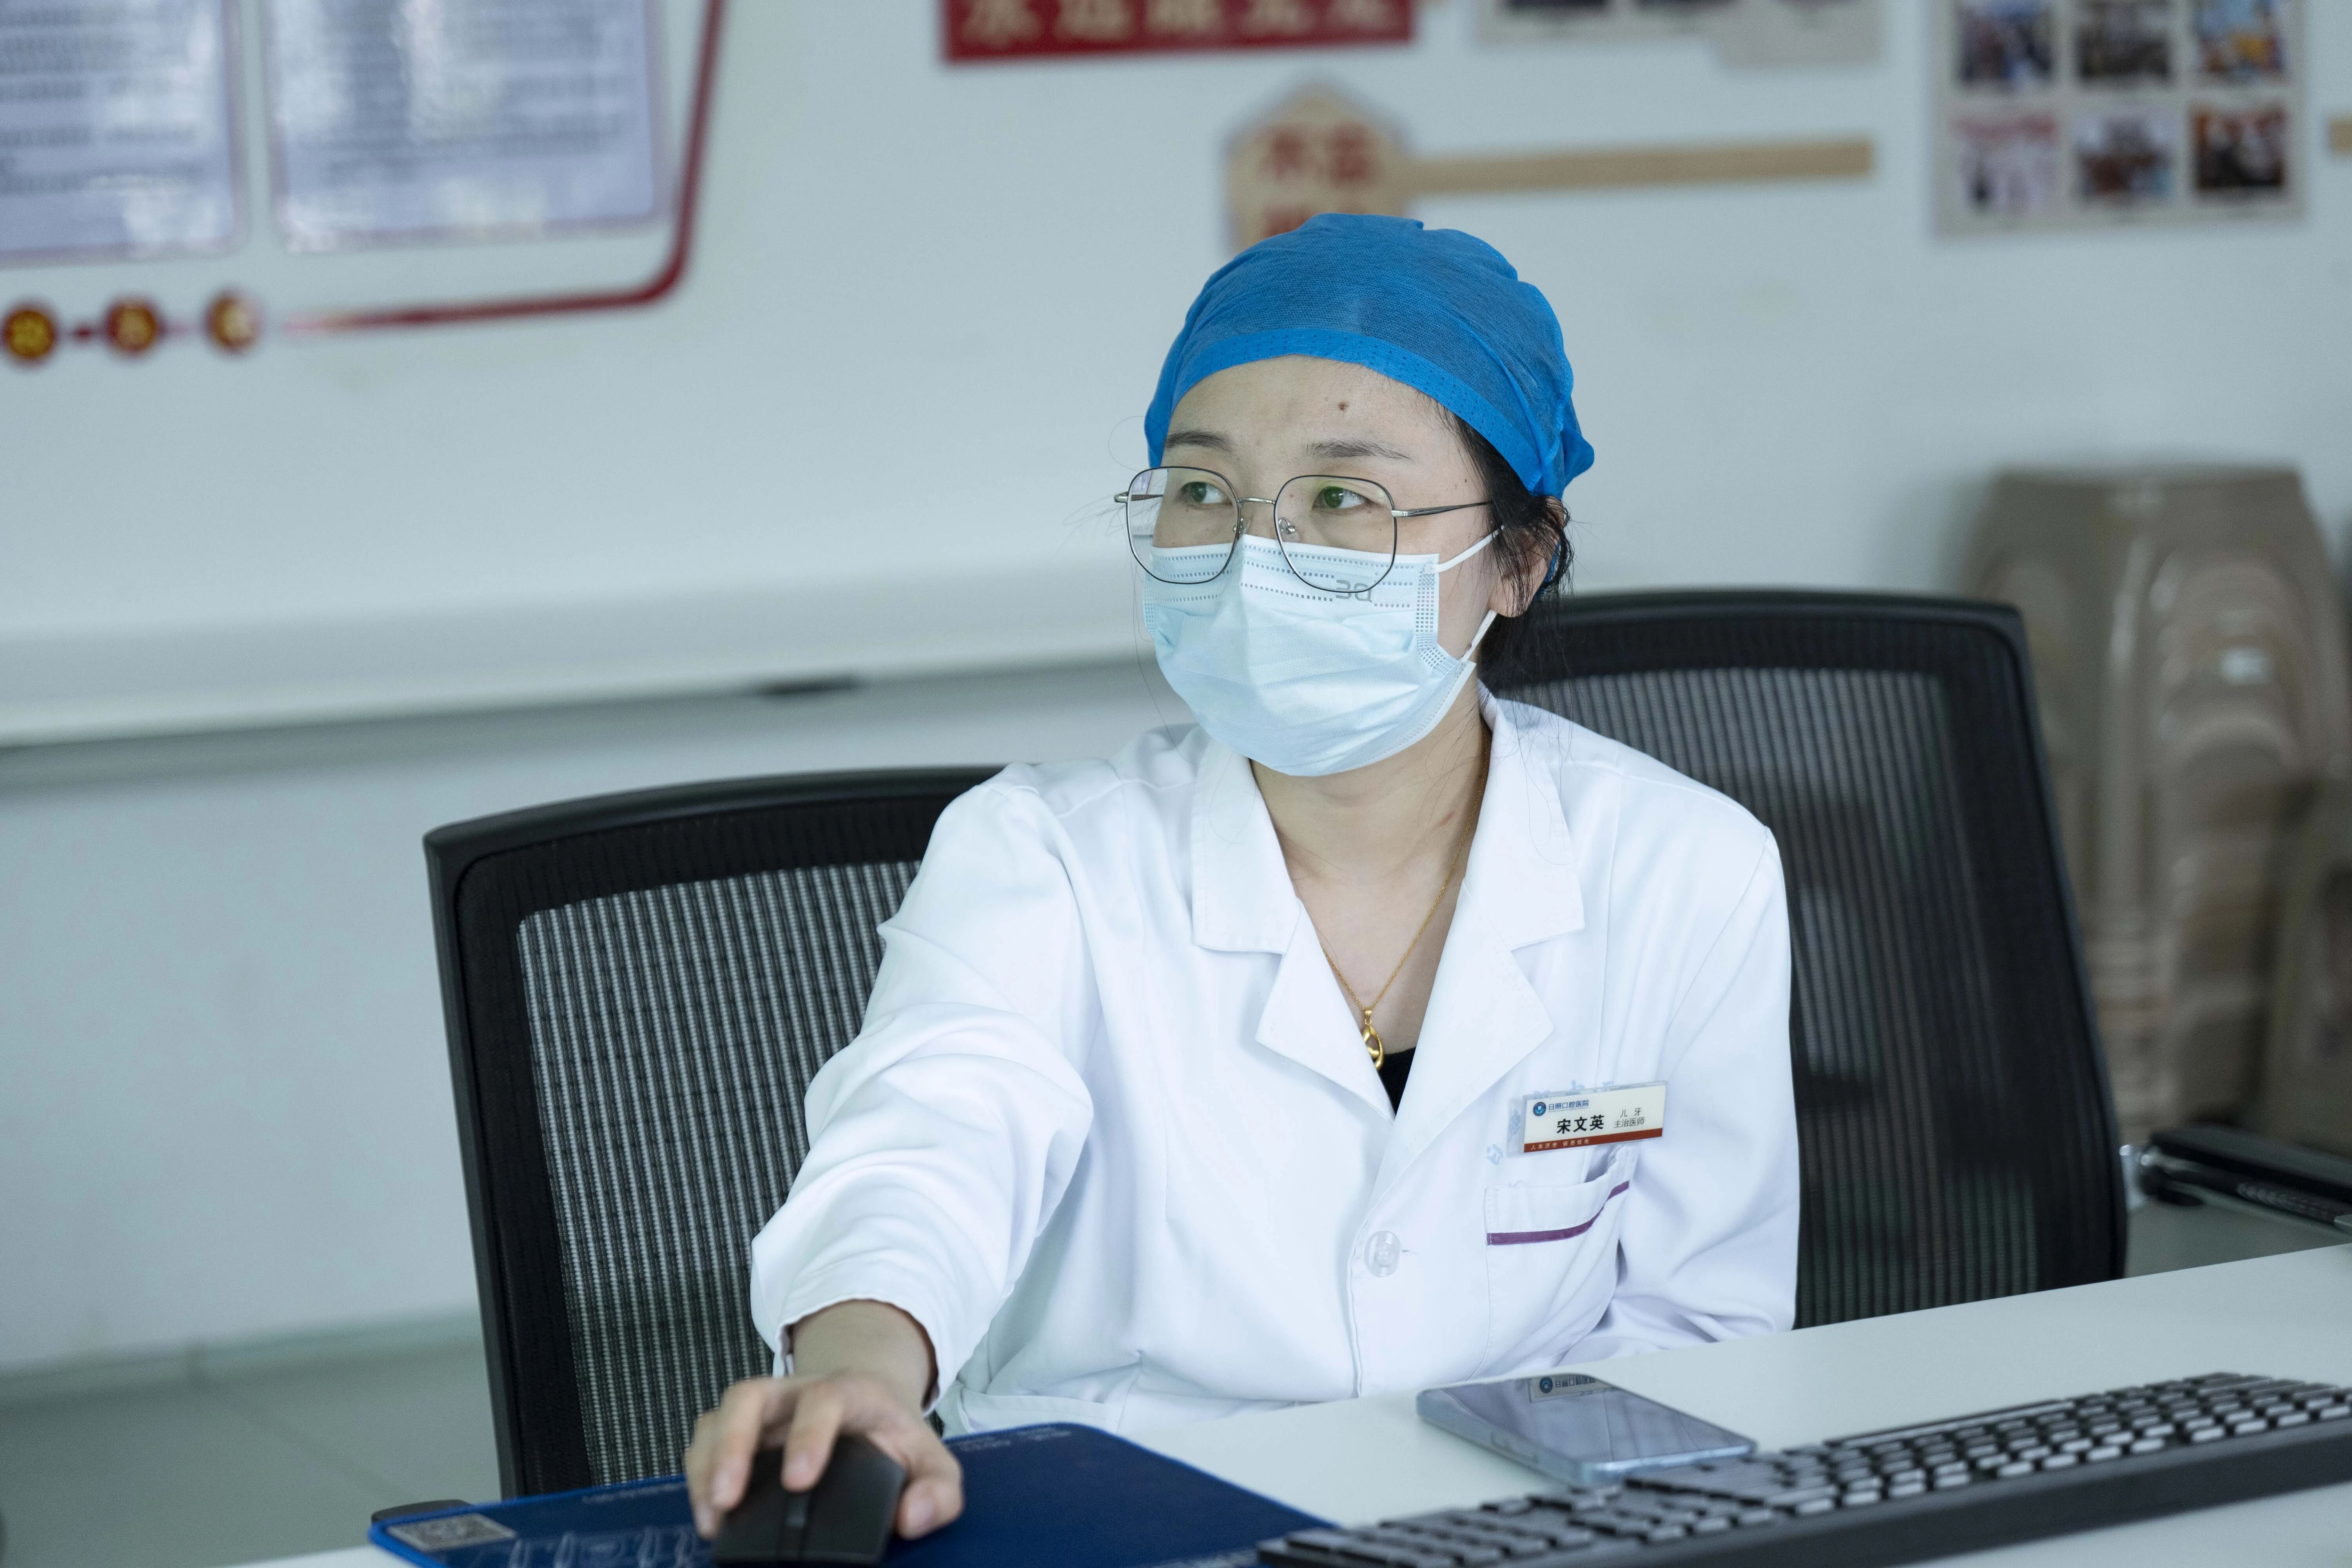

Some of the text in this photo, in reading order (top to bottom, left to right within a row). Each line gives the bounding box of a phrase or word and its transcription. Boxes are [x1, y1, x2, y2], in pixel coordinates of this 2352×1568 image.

[1549, 1100, 1589, 1110] 日照口腔医院
[1557, 1114, 1604, 1134] 宋文英
[1614, 1117, 1645, 1128] 主治医师
